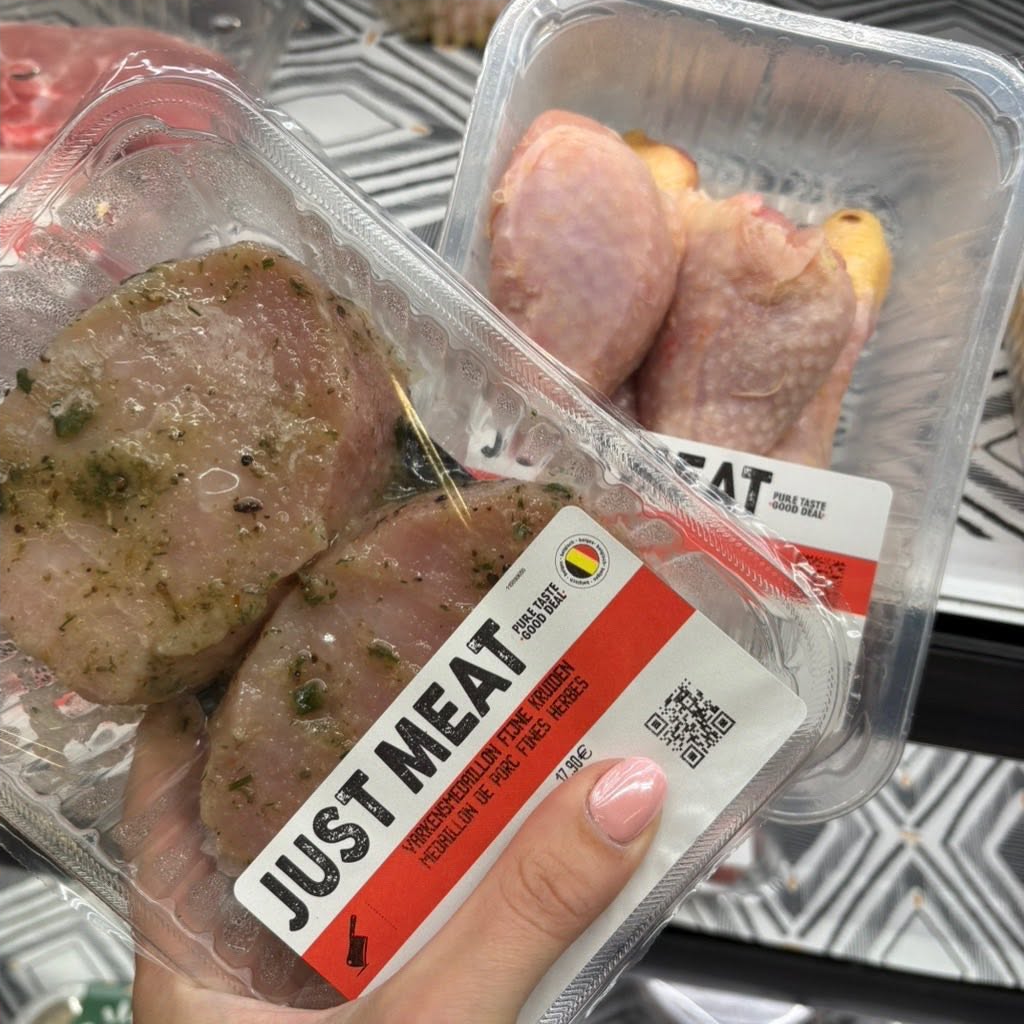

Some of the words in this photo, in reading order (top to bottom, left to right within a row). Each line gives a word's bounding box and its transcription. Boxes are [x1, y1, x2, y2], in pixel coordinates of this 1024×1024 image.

[772, 491, 798, 505] PURE
[800, 497, 826, 511] TASTE
[772, 501, 799, 514] GOOD
[801, 508, 825, 520] DEAL
[511, 607, 537, 634] PURE
[532, 582, 559, 610] TASTE
[522, 613, 547, 640] GOOD
[543, 591, 567, 616] DEAL
[258, 769, 395, 932] JUST
[374, 618, 527, 794] MEAT
[402, 743, 502, 854] VARKENSMEDAILLON
[496, 706, 534, 748] FIJNE
[527, 660, 576, 712] KRUIDEN
[418, 801, 479, 869] MEDAILLON
[473, 783, 495, 806] DE
[491, 754, 521, 787] PORC
[515, 717, 552, 756] FINES
[545, 675, 590, 721] HERBES
